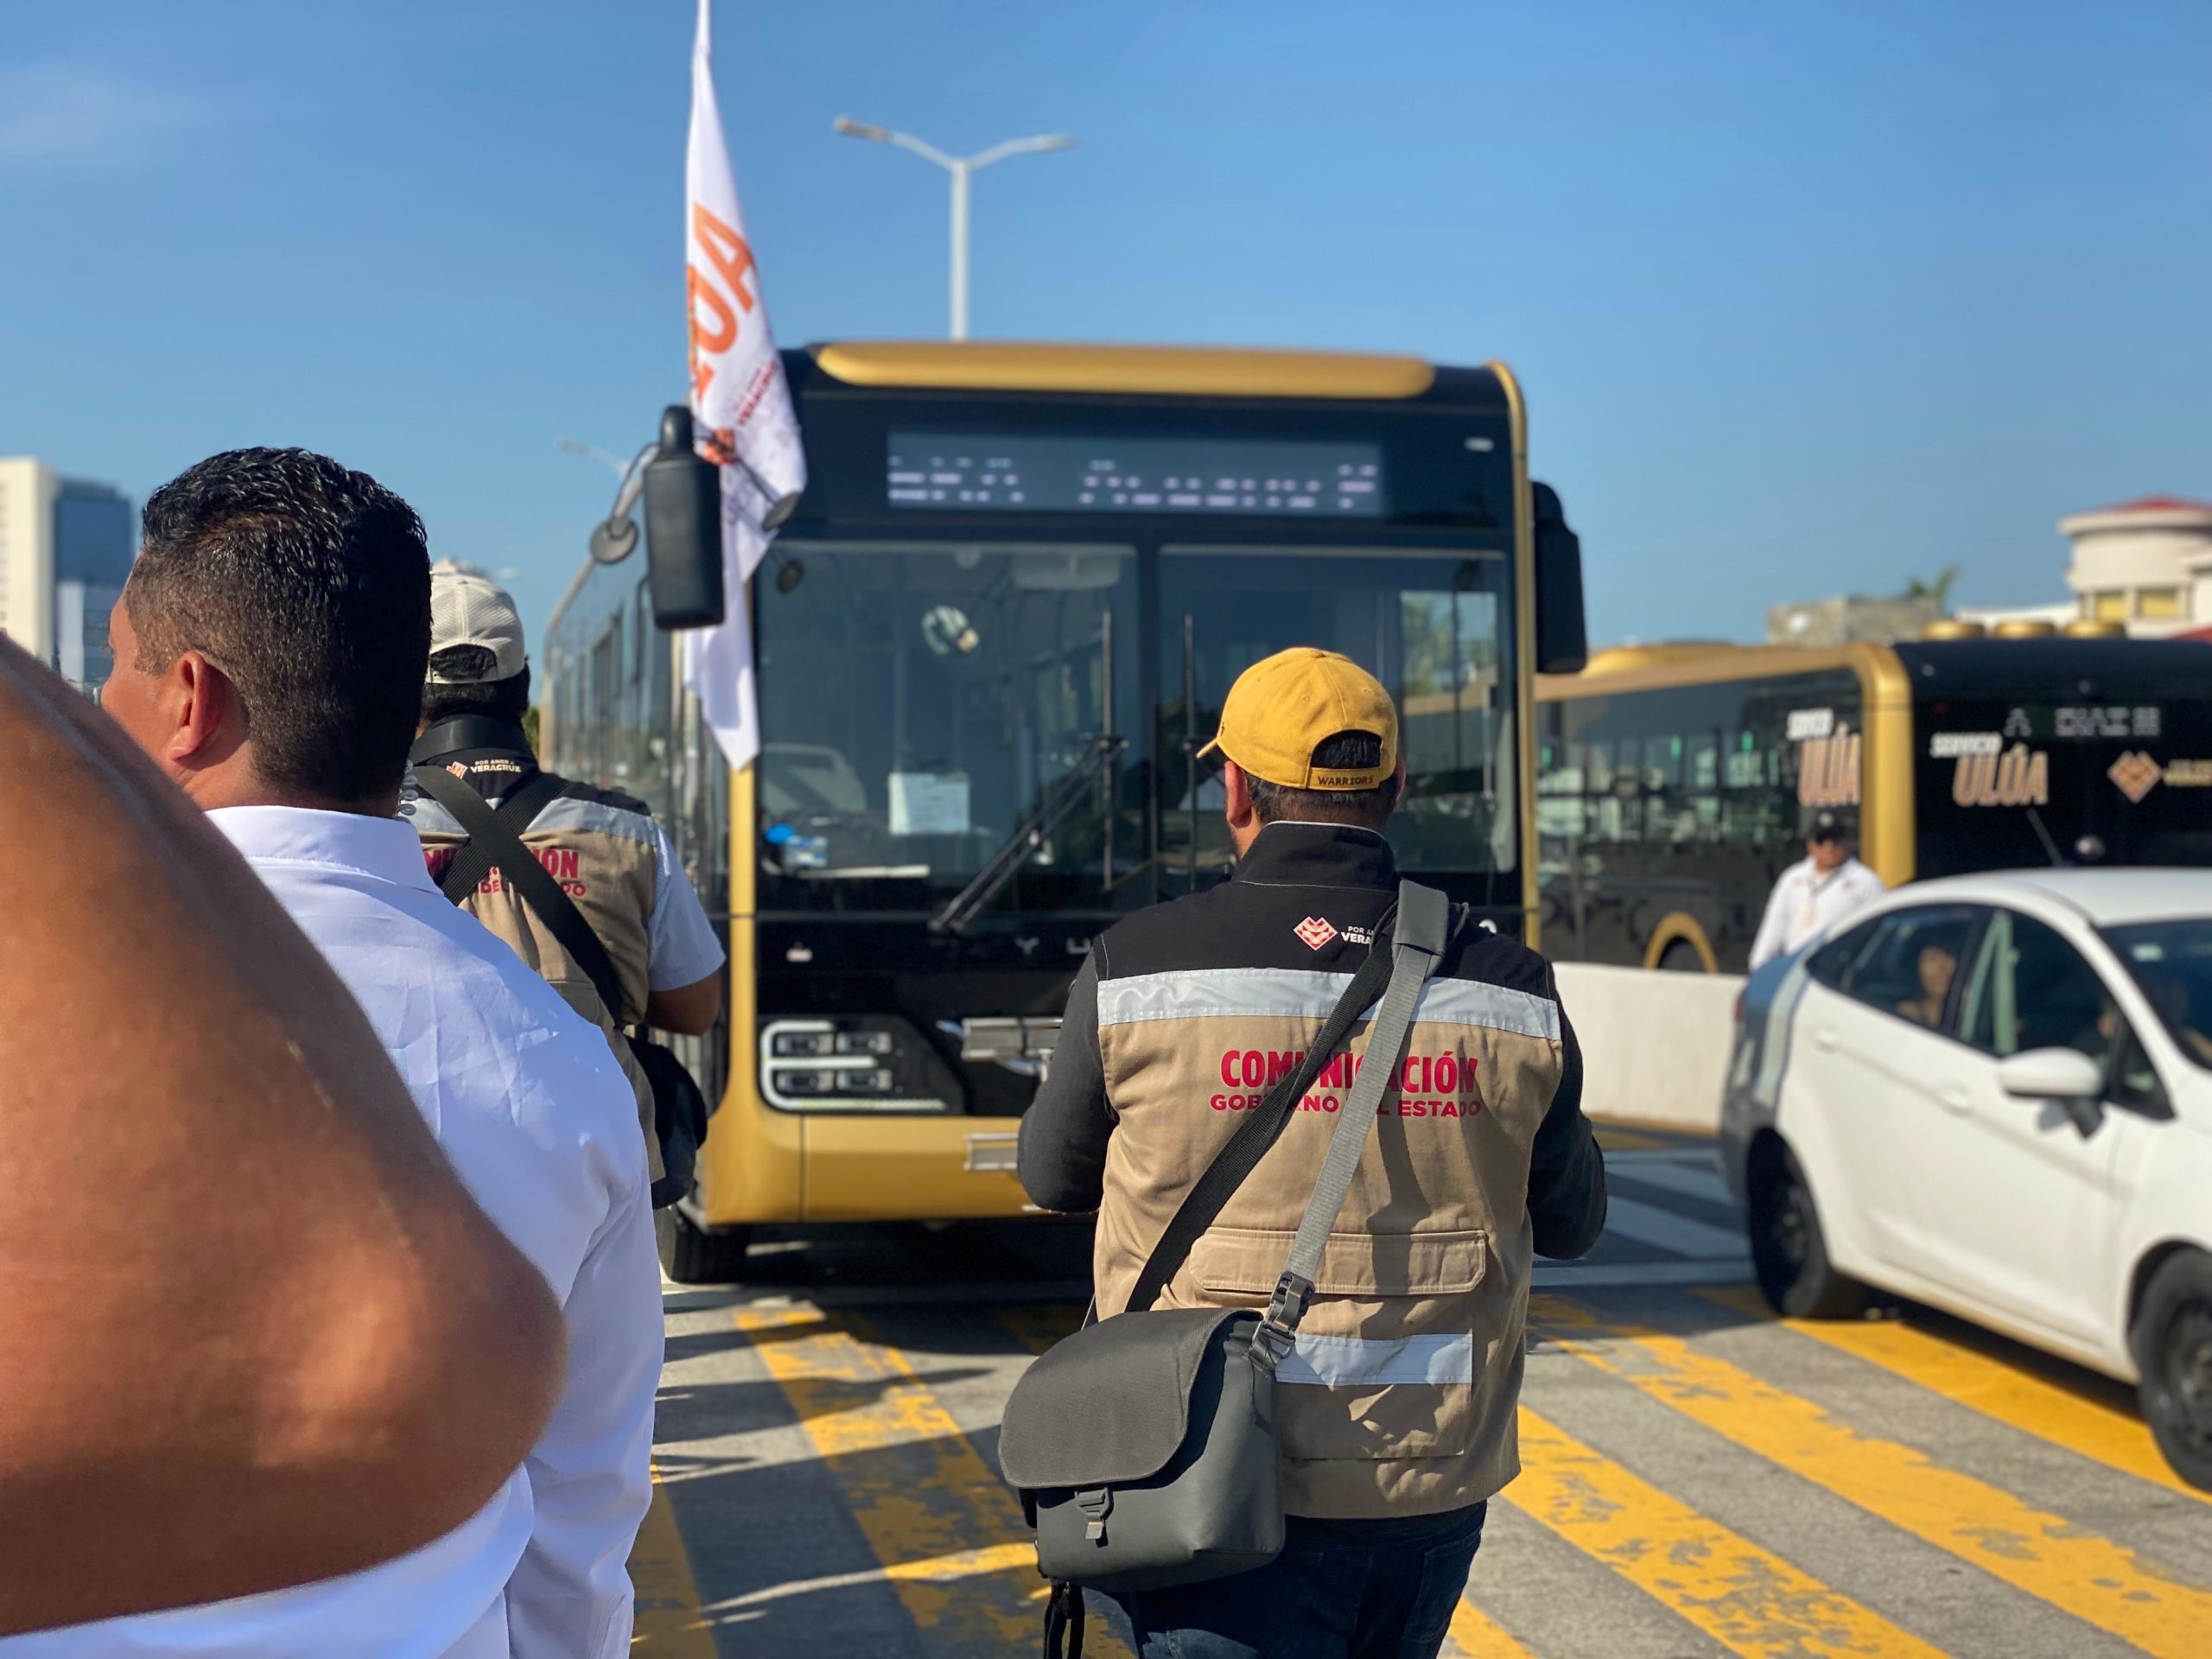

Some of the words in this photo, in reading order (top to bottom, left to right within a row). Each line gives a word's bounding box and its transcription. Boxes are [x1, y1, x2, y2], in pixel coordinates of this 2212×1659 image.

[470, 765, 522, 773] VERACRUZ
[1318, 776, 1374, 785] WARRIORS
[1953, 743, 2049, 807] ULÚA
[1348, 925, 1364, 934] POR
[1341, 931, 1372, 944] VERA
[1397, 1099, 1481, 1117] ESTADO
